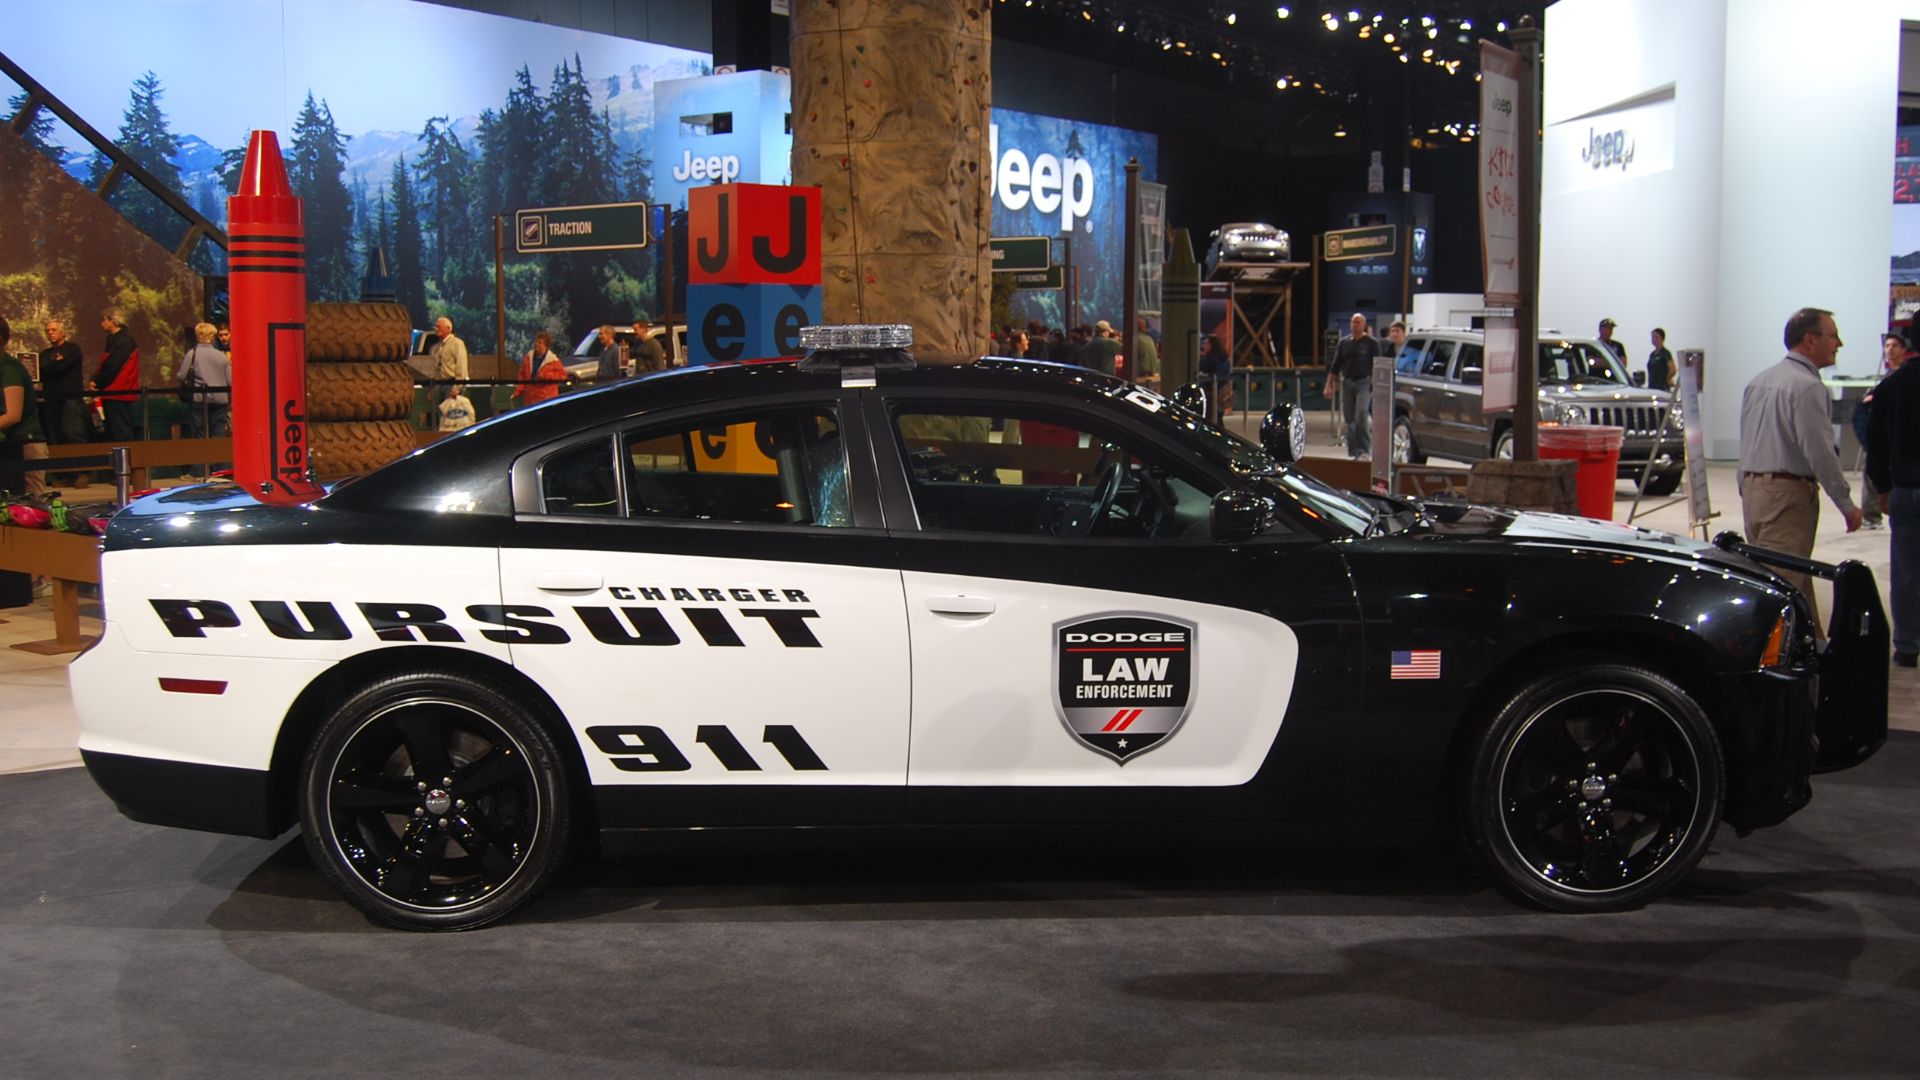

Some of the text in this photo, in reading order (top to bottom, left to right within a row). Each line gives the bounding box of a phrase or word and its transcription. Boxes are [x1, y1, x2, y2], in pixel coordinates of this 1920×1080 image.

[673, 150, 739, 184] Jeep
[1582, 126, 1630, 169] Jeep
[549, 221, 592, 236] TRACTION
[697, 193, 729, 274] J
[752, 195, 807, 274] J
[702, 303, 746, 361] e
[282, 400, 305, 484] Jeep
[608, 587, 811, 602] CHARGER
[147, 599, 823, 648] PURSUIT
[1066, 633, 1185, 643] DODGE
[1083, 658, 1170, 681] LAW
[1076, 685, 1173, 699] ENFORCEMENT
[585, 725, 830, 772] 911
